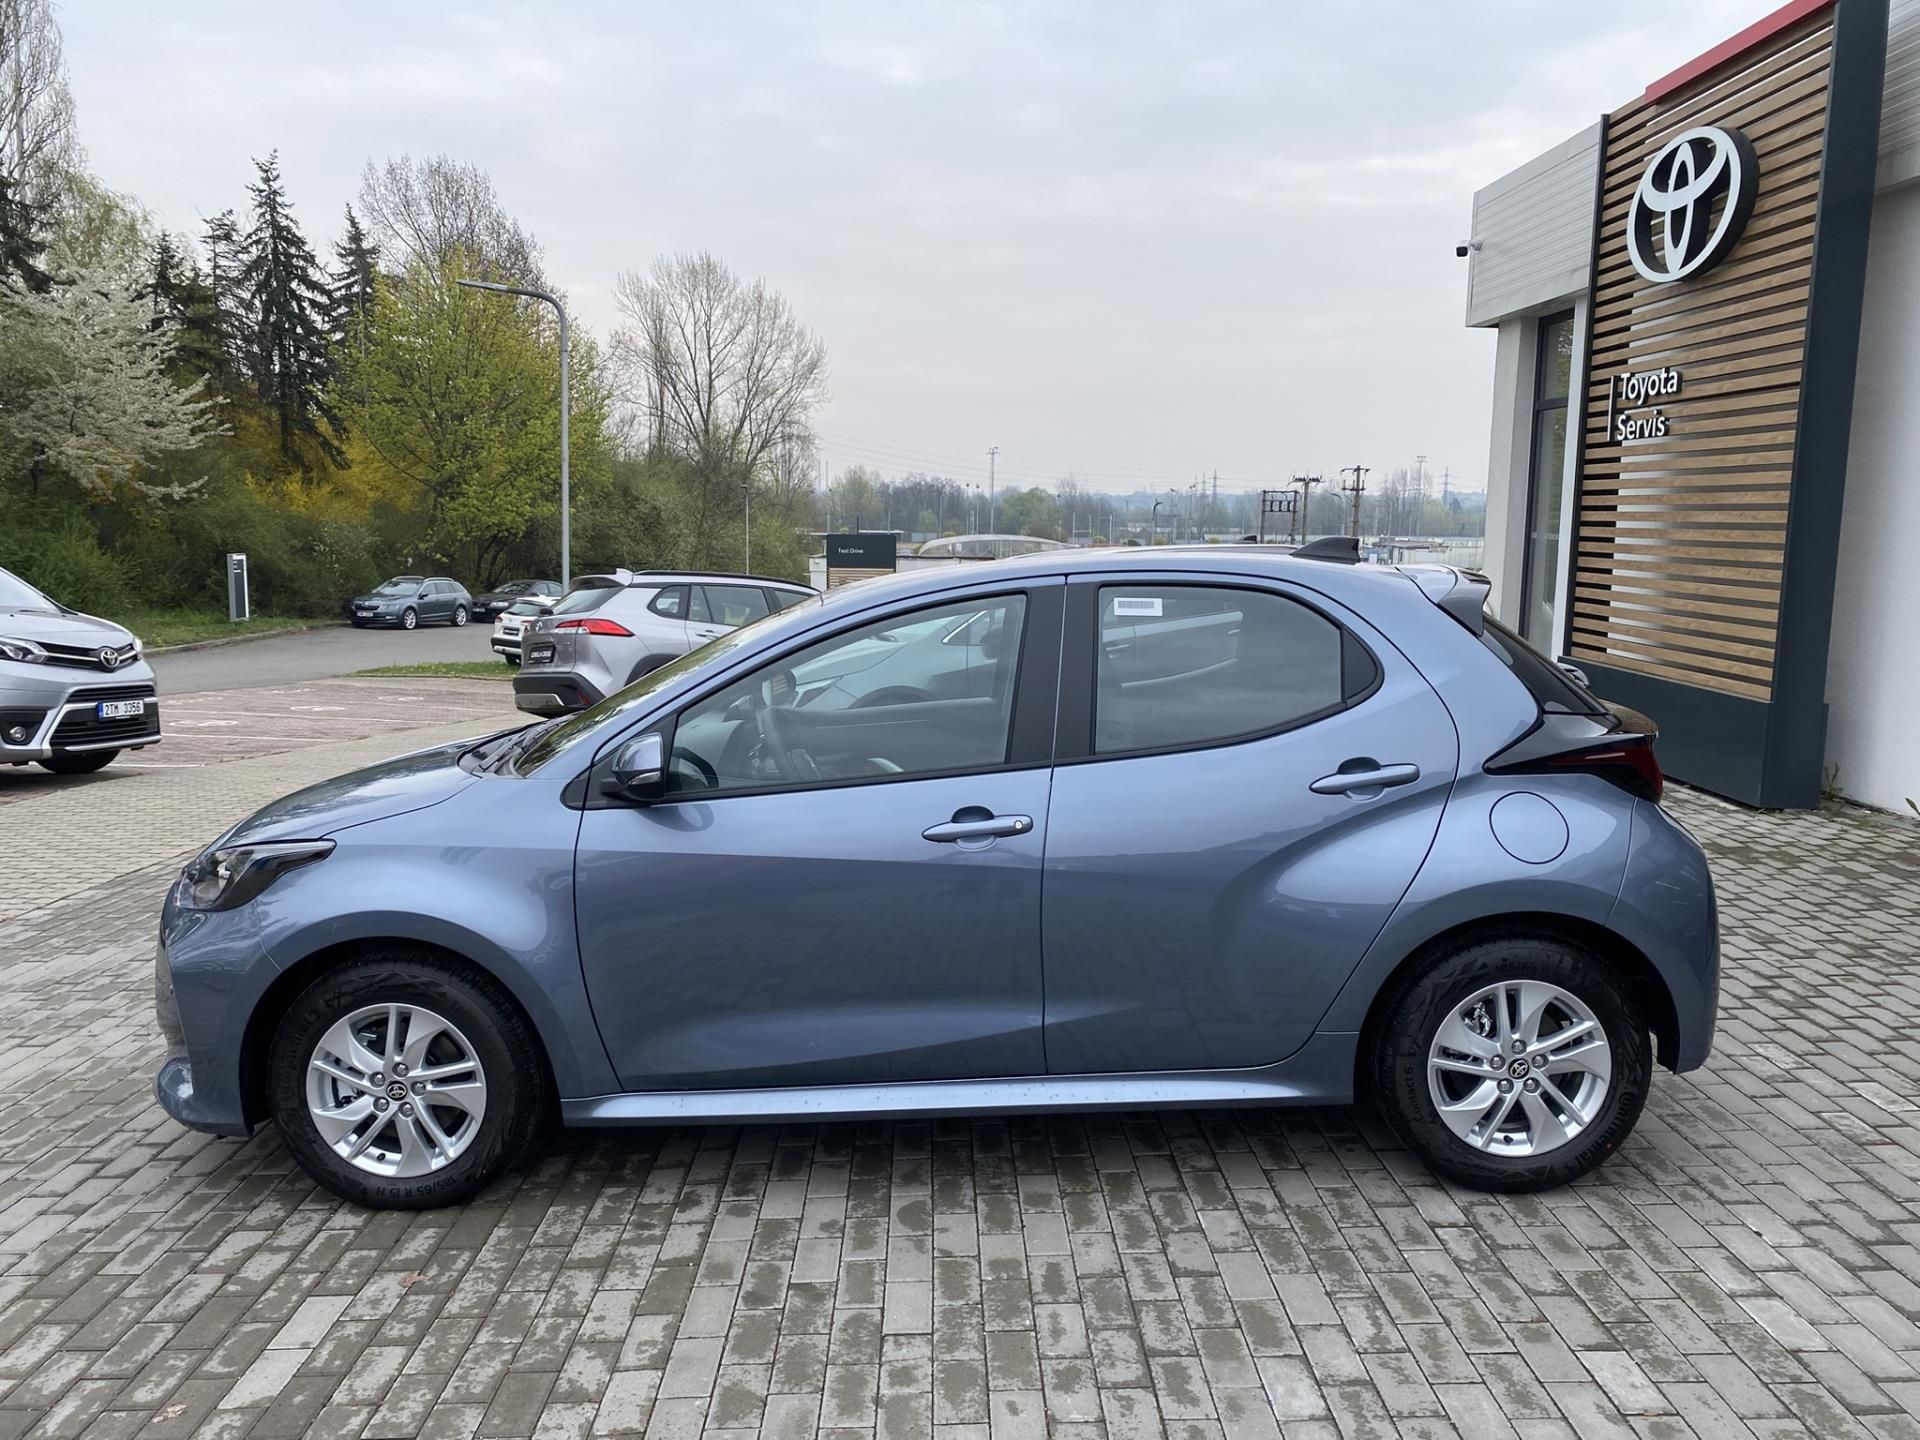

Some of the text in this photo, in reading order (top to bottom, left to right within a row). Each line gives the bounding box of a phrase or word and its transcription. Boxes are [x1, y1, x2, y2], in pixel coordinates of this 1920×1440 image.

[1621, 367, 1678, 405] Toyota
[1617, 409, 1665, 440] Servis
[105, 703, 119, 715] 2TM
[1574, 1091, 1637, 1169] Continental
[376, 1176, 457, 1199] 185/65 R 15 H
